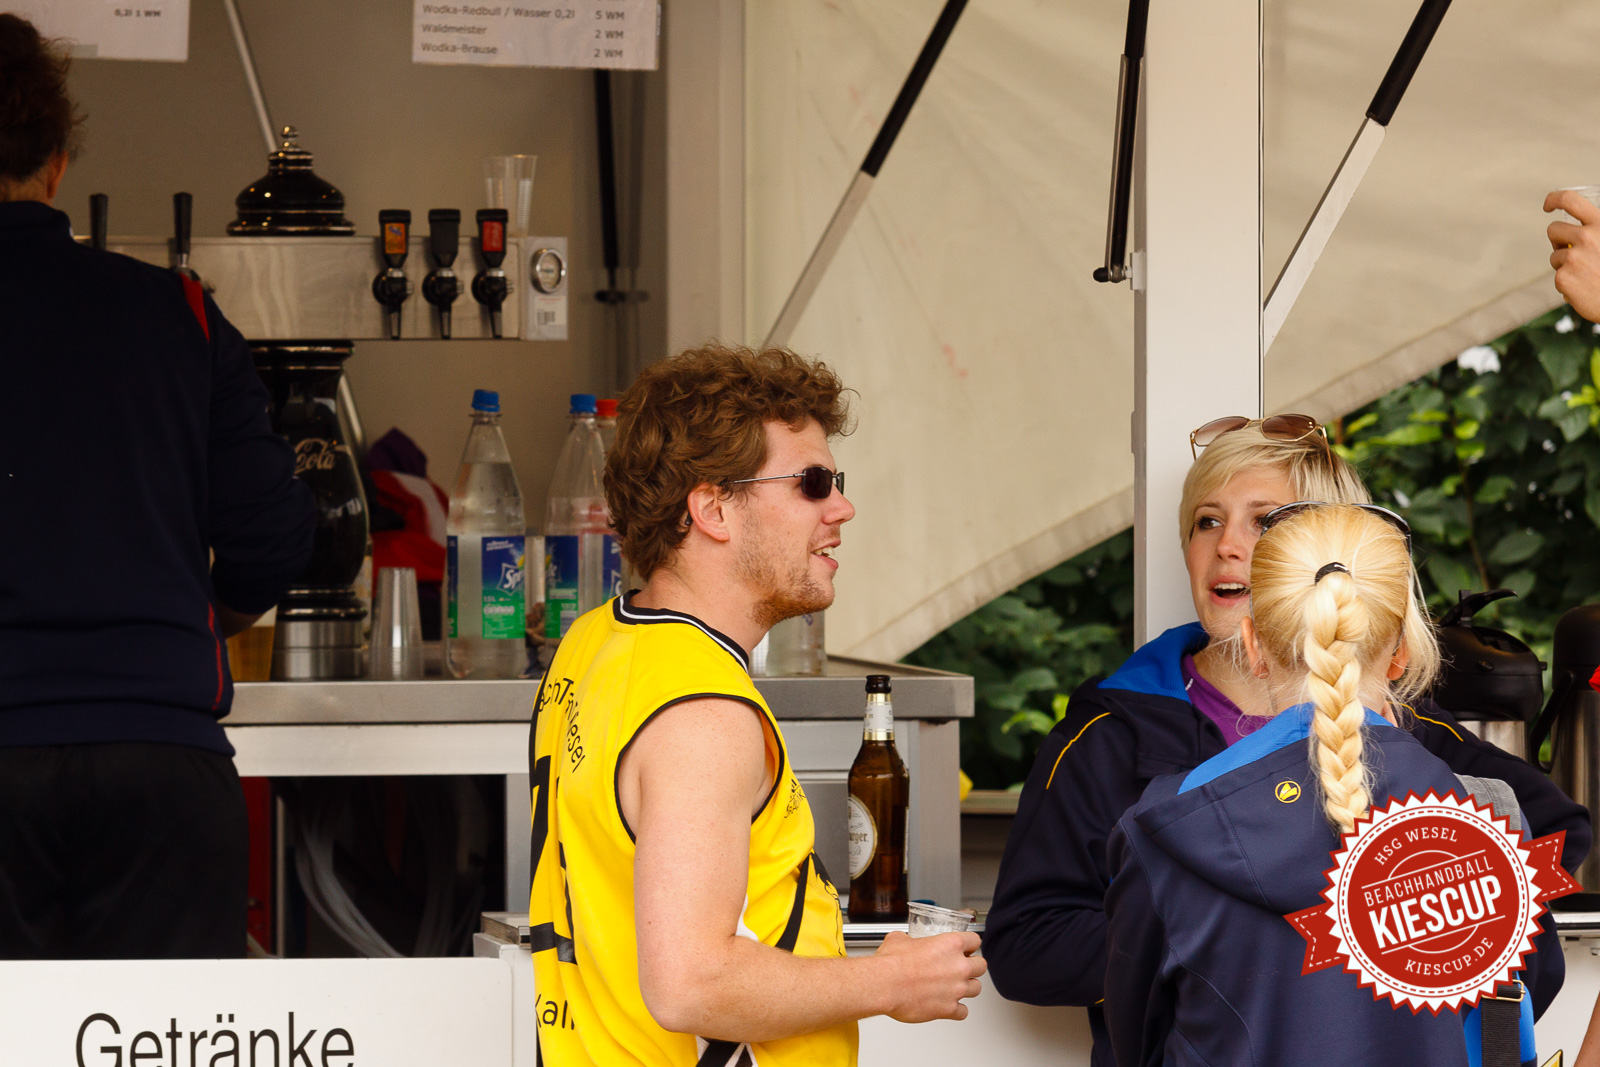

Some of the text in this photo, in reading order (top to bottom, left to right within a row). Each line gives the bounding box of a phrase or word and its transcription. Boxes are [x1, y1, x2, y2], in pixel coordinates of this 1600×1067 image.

[422, 5, 501, 16] Wodka-Redbull
[513, 8, 551, 18] Wasser
[595, 10, 602, 20] 5
[605, 11, 625, 20] WM
[421, 24, 624, 39] Waldmeister 2 WM
[421, 43, 623, 58] Wodka-Brause 2 WM
[76, 1012, 355, 1067] Getränke
